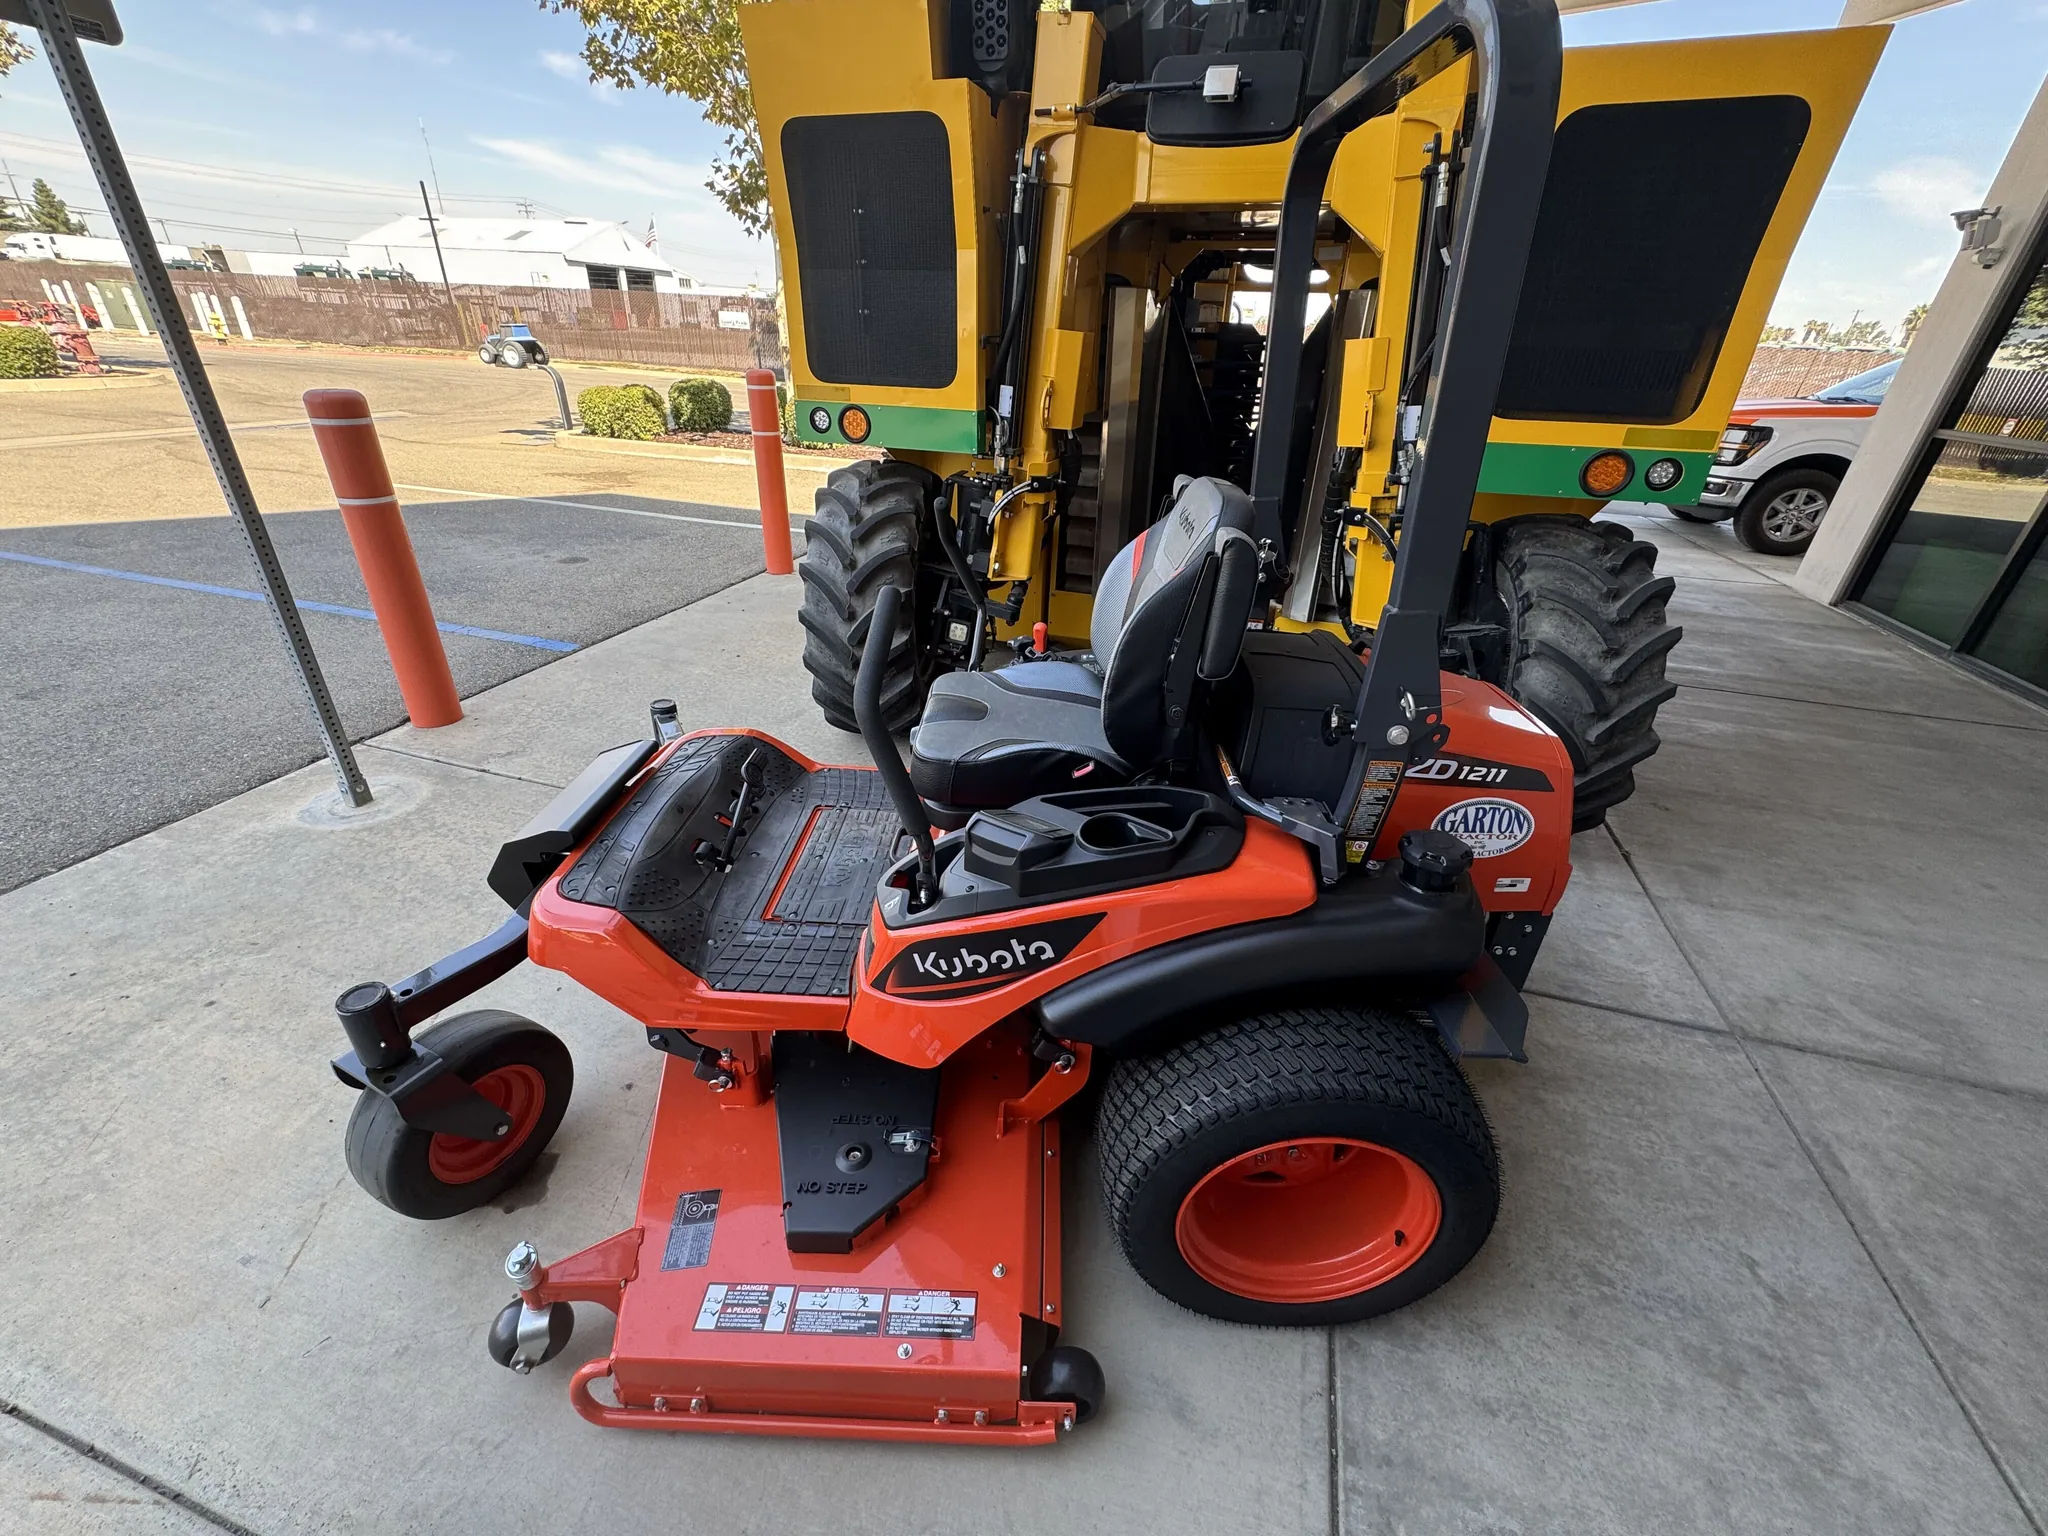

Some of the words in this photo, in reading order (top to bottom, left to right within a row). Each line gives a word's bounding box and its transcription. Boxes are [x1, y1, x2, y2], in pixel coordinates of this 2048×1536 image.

[1458, 766, 1508, 782] 1211
[1440, 806, 1527, 834] GARTON
[1454, 833, 1518, 841] RACTOR
[912, 938, 1055, 979] Kubota
[831, 1113, 871, 1125] STEP
[874, 1113, 897, 1126] NO
[797, 1181, 821, 1193] NO
[826, 1181, 868, 1194] STEP
